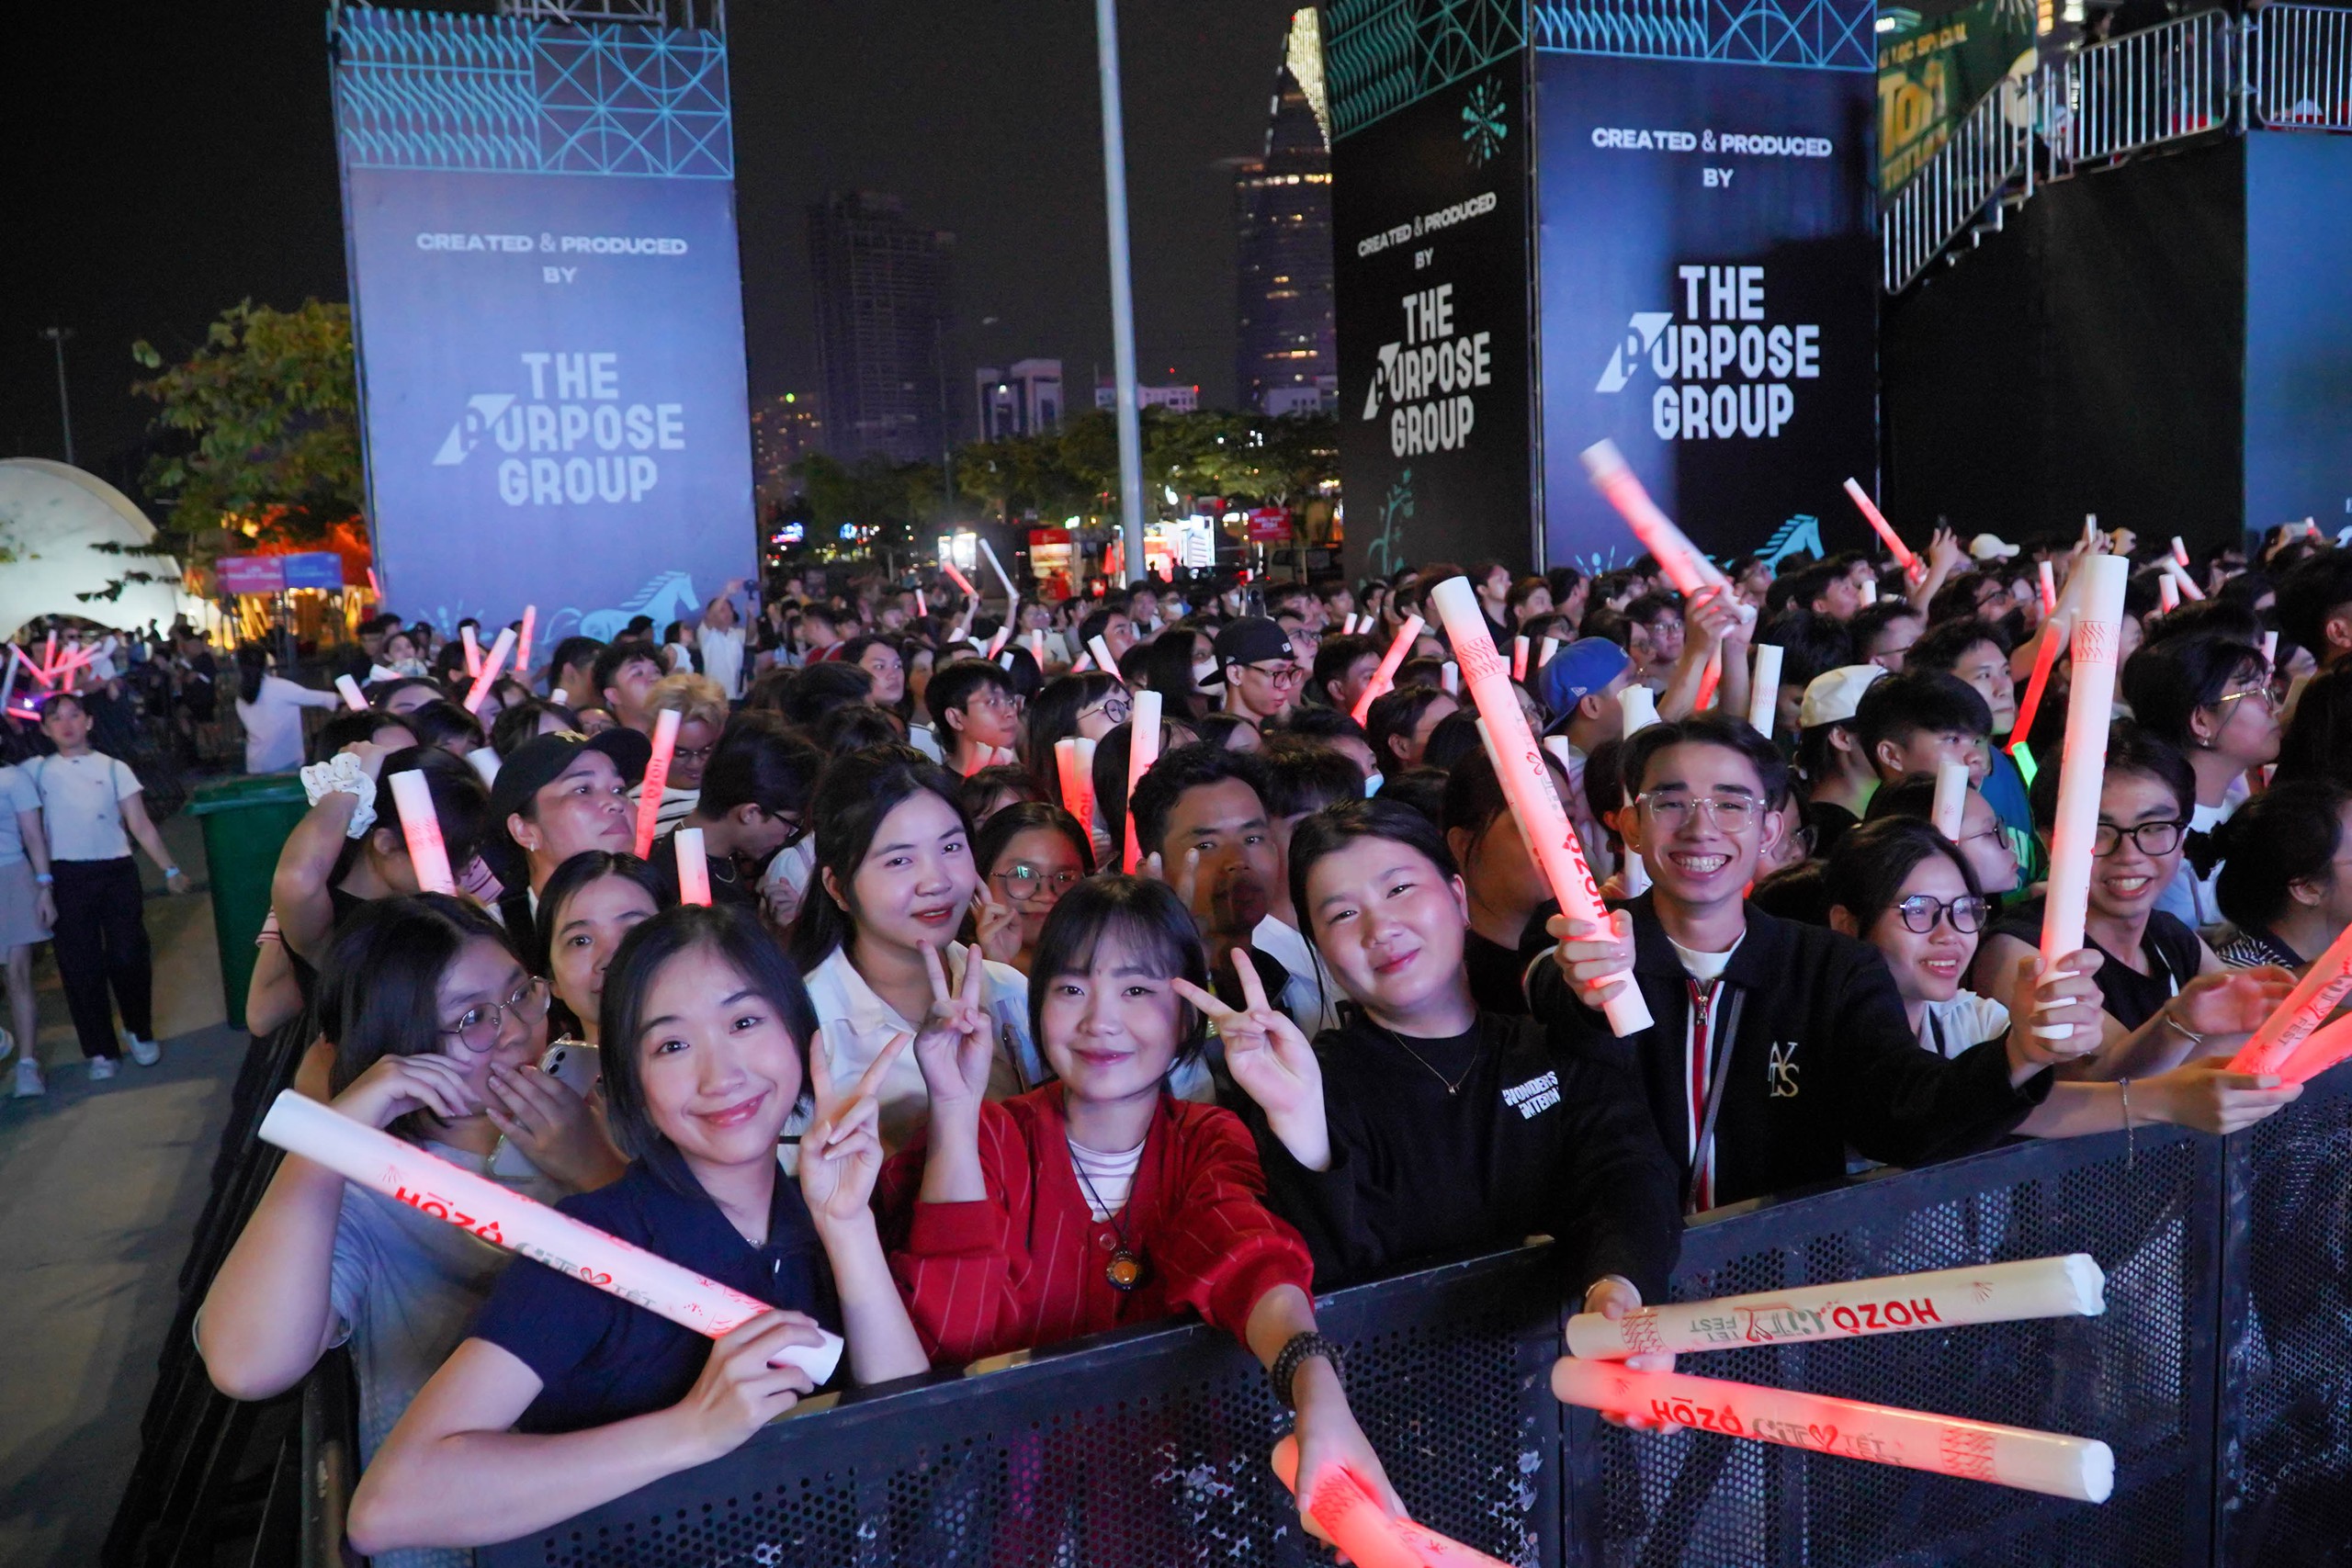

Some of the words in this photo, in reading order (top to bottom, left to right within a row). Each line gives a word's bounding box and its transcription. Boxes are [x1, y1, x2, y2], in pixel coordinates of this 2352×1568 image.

[1591, 127, 1697, 152] CREATED
[1702, 129, 1716, 152] &
[1721, 133, 1833, 157] PRODUCED
[1702, 167, 1735, 187] BY
[416, 232, 534, 252] CREATED
[539, 232, 556, 253] &
[561, 236, 688, 254] PRODUCED
[1357, 223, 1412, 257] CREATED
[1413, 215, 1423, 237] &
[1424, 191, 1497, 233] PRODUCED
[543, 265, 578, 283] BY
[1414, 247, 1434, 270] BY
[1402, 283, 1453, 345] THE
[1679, 265, 1765, 321] THE
[1595, 311, 1820, 393] PURPOSE
[521, 353, 619, 400] THE
[1363, 332, 1491, 421] PURPOSE
[432, 393, 685, 465] PURPOSE
[1391, 395, 1475, 457] GROUP
[1653, 384, 1793, 440] GROUP
[498, 456, 658, 506] GROUP
[2278, 1017, 2309, 1047] FEST
[1501, 1071, 1558, 1106] WONDERS
[1690, 1315, 1736, 1332] FEST
